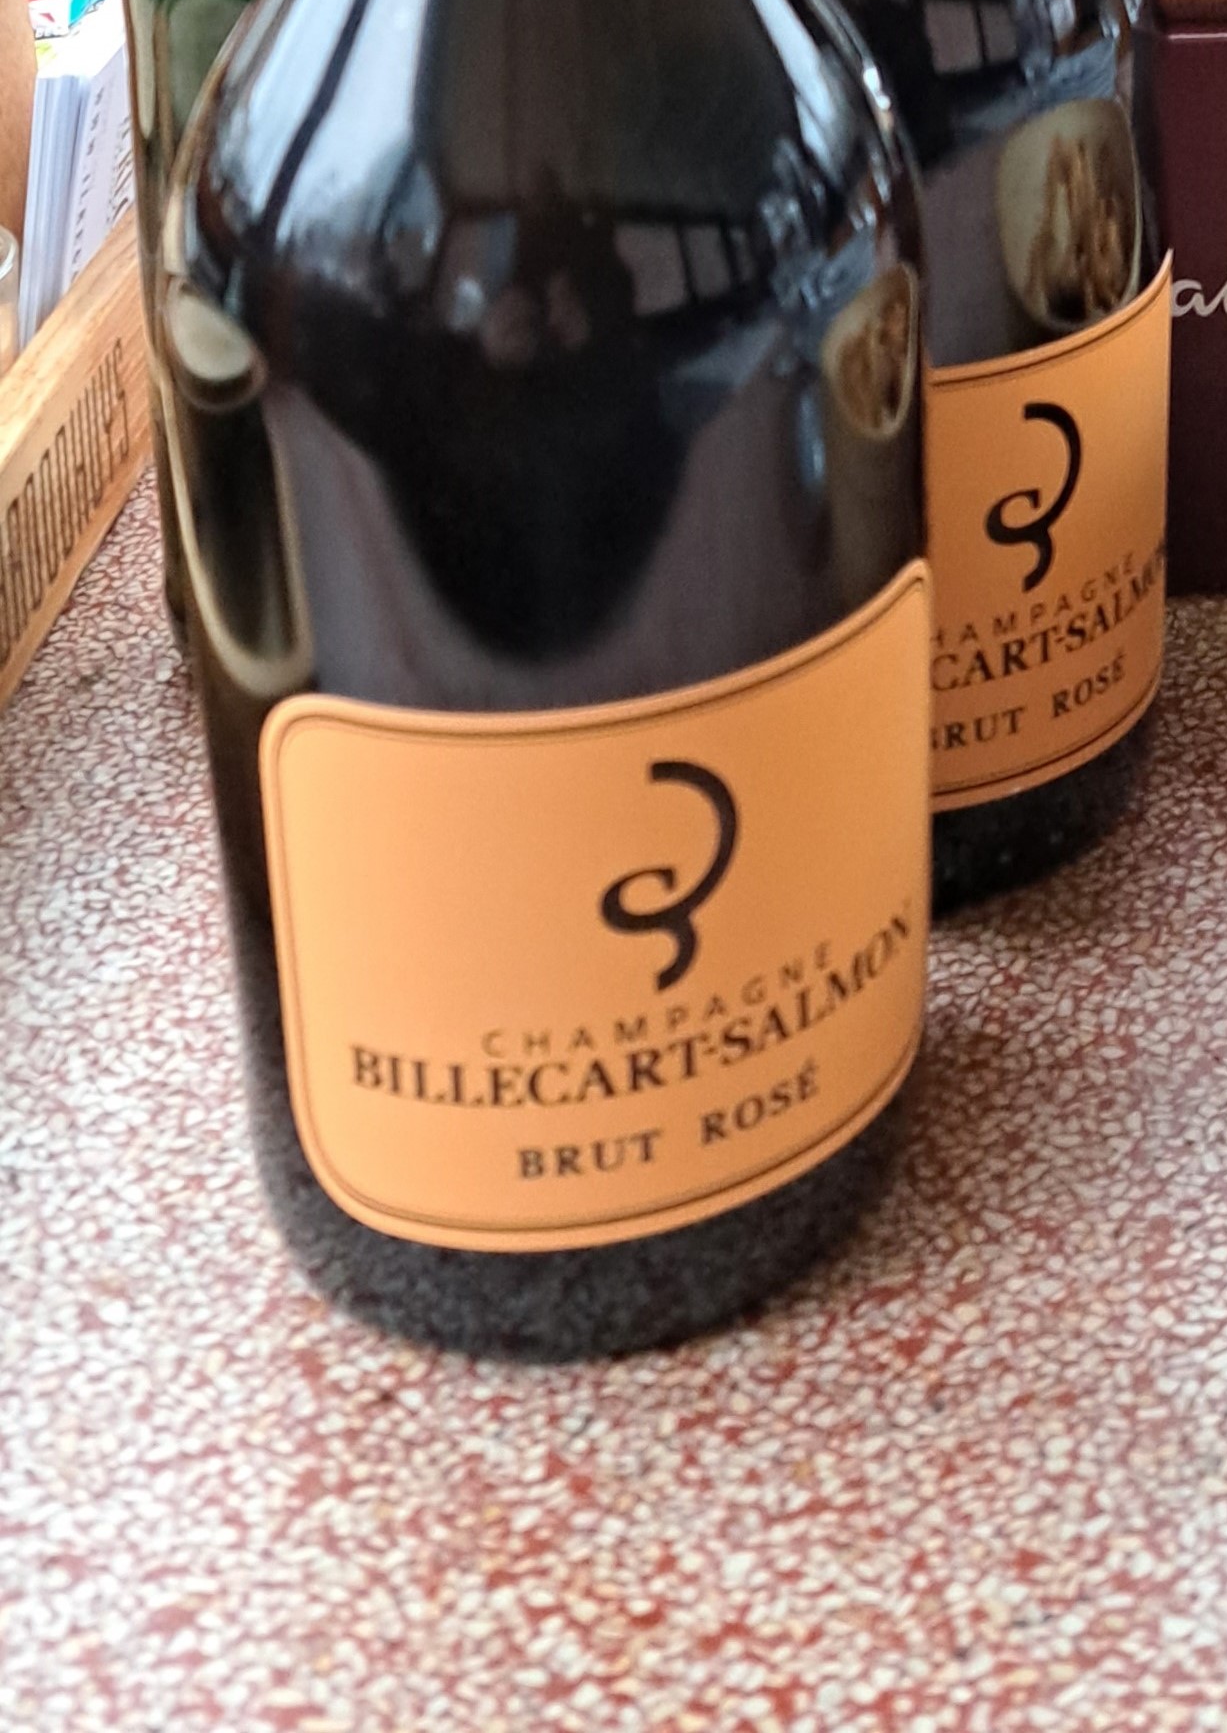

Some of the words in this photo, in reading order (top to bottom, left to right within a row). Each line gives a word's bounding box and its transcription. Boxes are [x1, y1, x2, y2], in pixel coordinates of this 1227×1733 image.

[930, 550, 1134, 649] HAMPAGNE
[480, 938, 831, 1060] CHAMPAGNE
[517, 1127, 663, 1180] BRUT
[701, 1055, 820, 1145] ROSÉ
